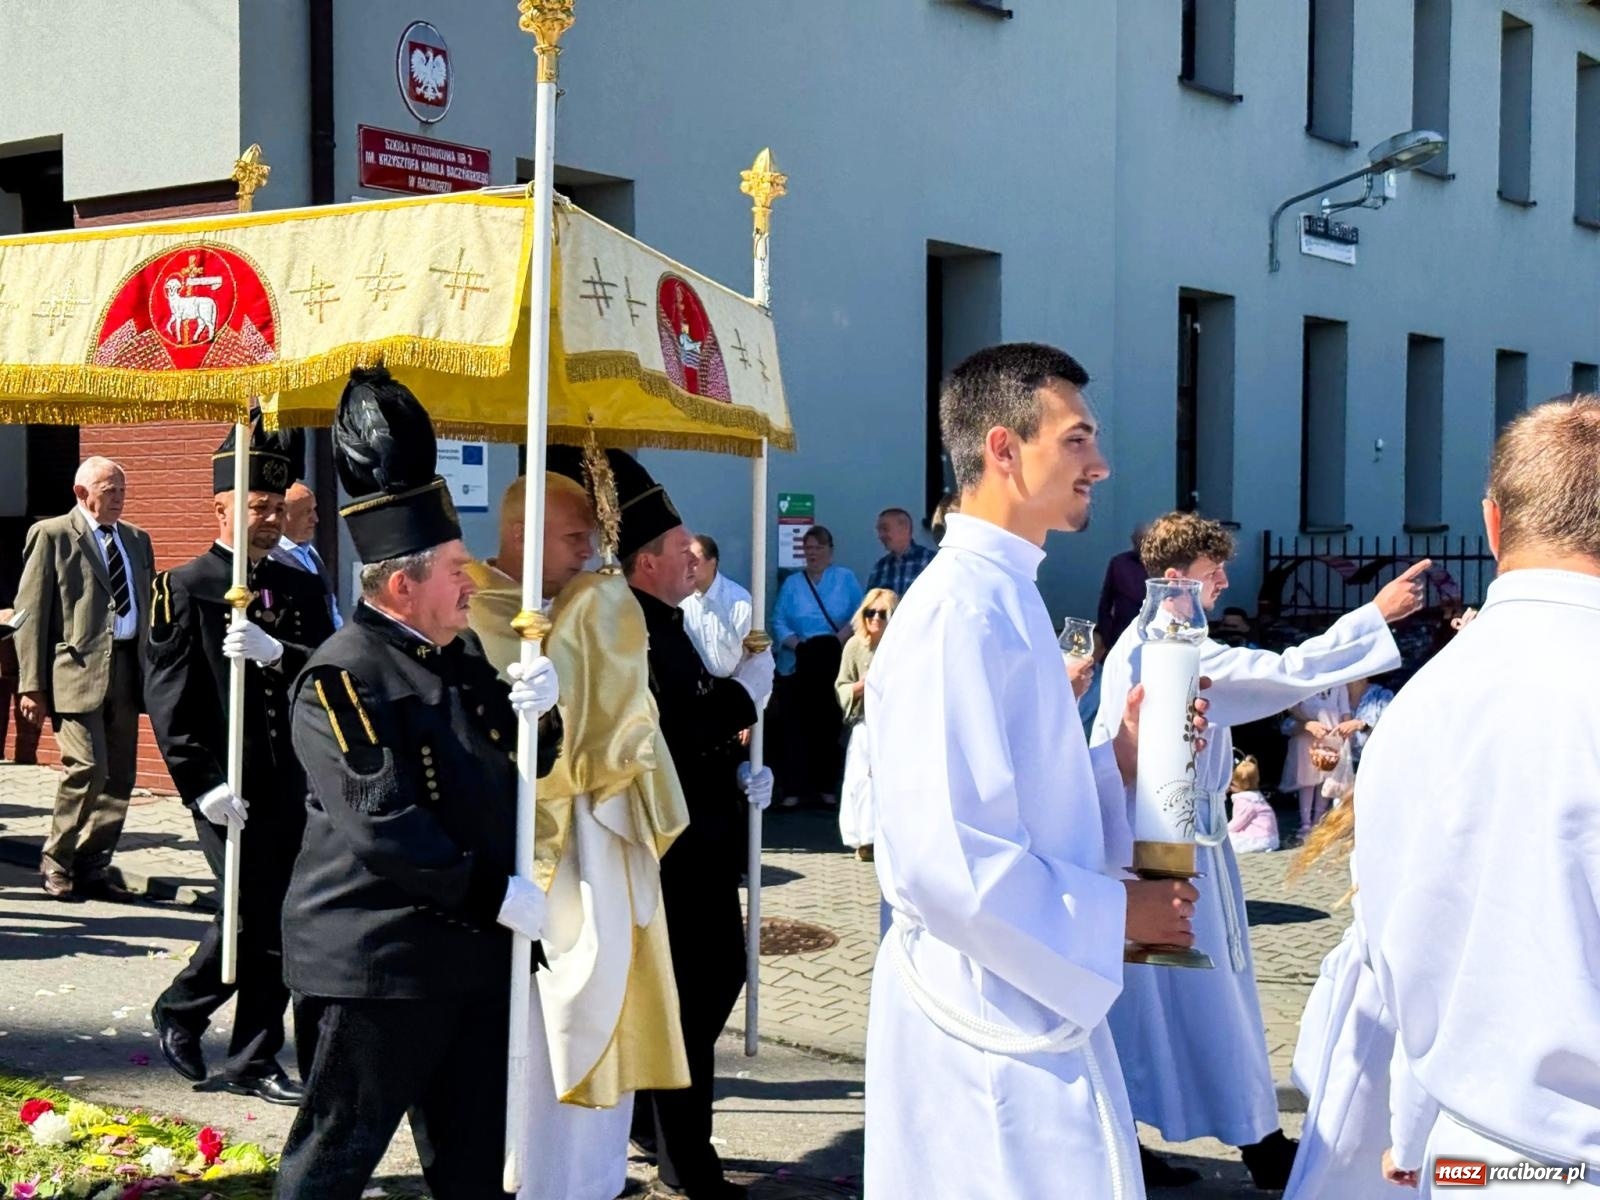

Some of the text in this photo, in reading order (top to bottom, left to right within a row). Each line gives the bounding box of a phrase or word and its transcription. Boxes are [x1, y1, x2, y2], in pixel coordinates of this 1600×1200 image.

[384, 138, 410, 153] SZKOŁA
[379, 153, 419, 171] KRZYSZTOFA
[408, 175, 415, 187] W
